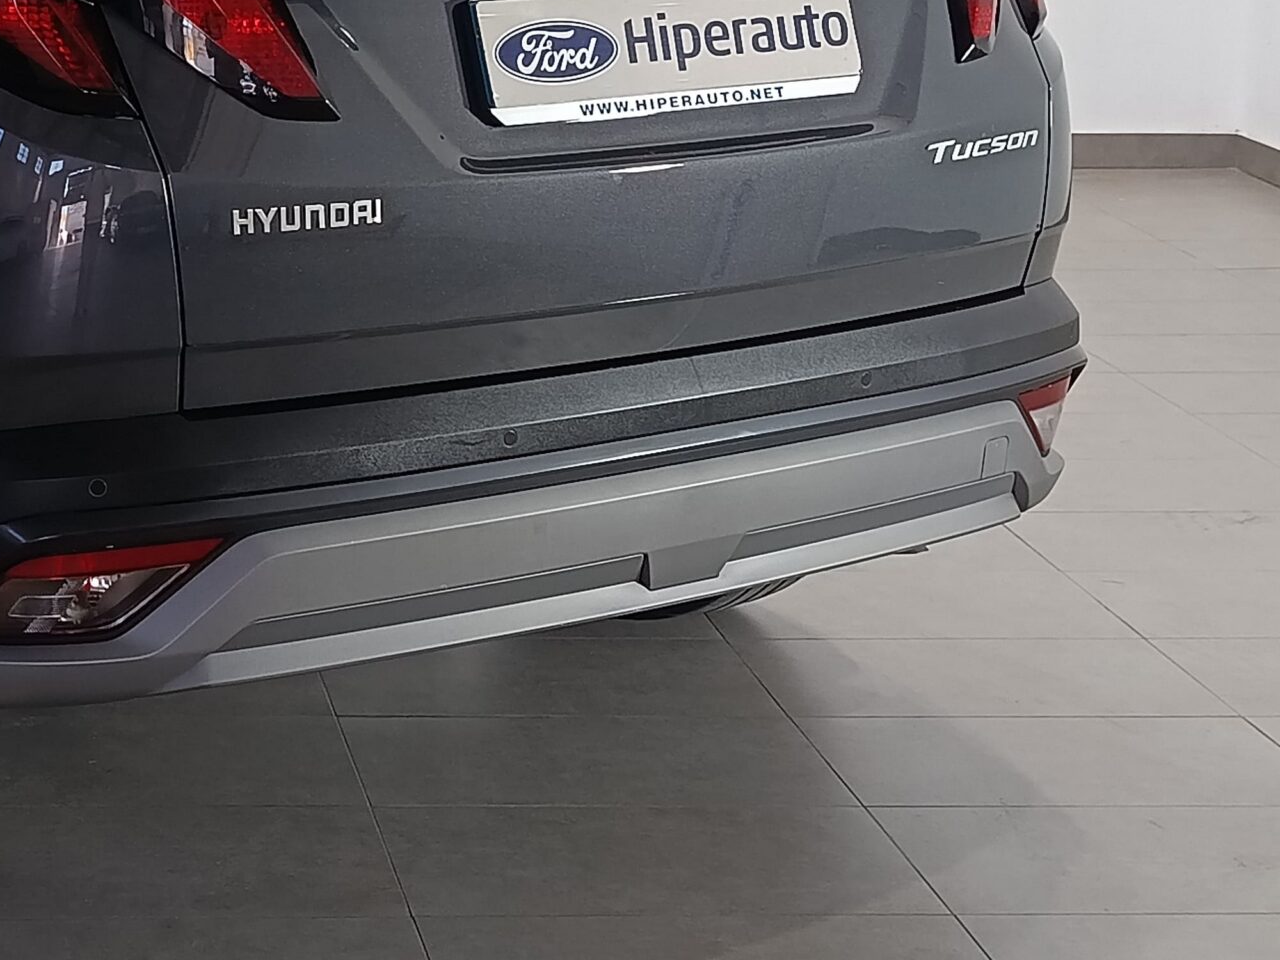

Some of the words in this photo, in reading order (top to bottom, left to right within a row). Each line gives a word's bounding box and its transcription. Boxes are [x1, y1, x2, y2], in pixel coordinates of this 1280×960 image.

[517, 29, 599, 75] Ford
[623, 5, 849, 71] Hiperauto
[579, 86, 784, 116] WWW.HIPERAUTO.NET
[231, 197, 382, 236] HYUNDAI
